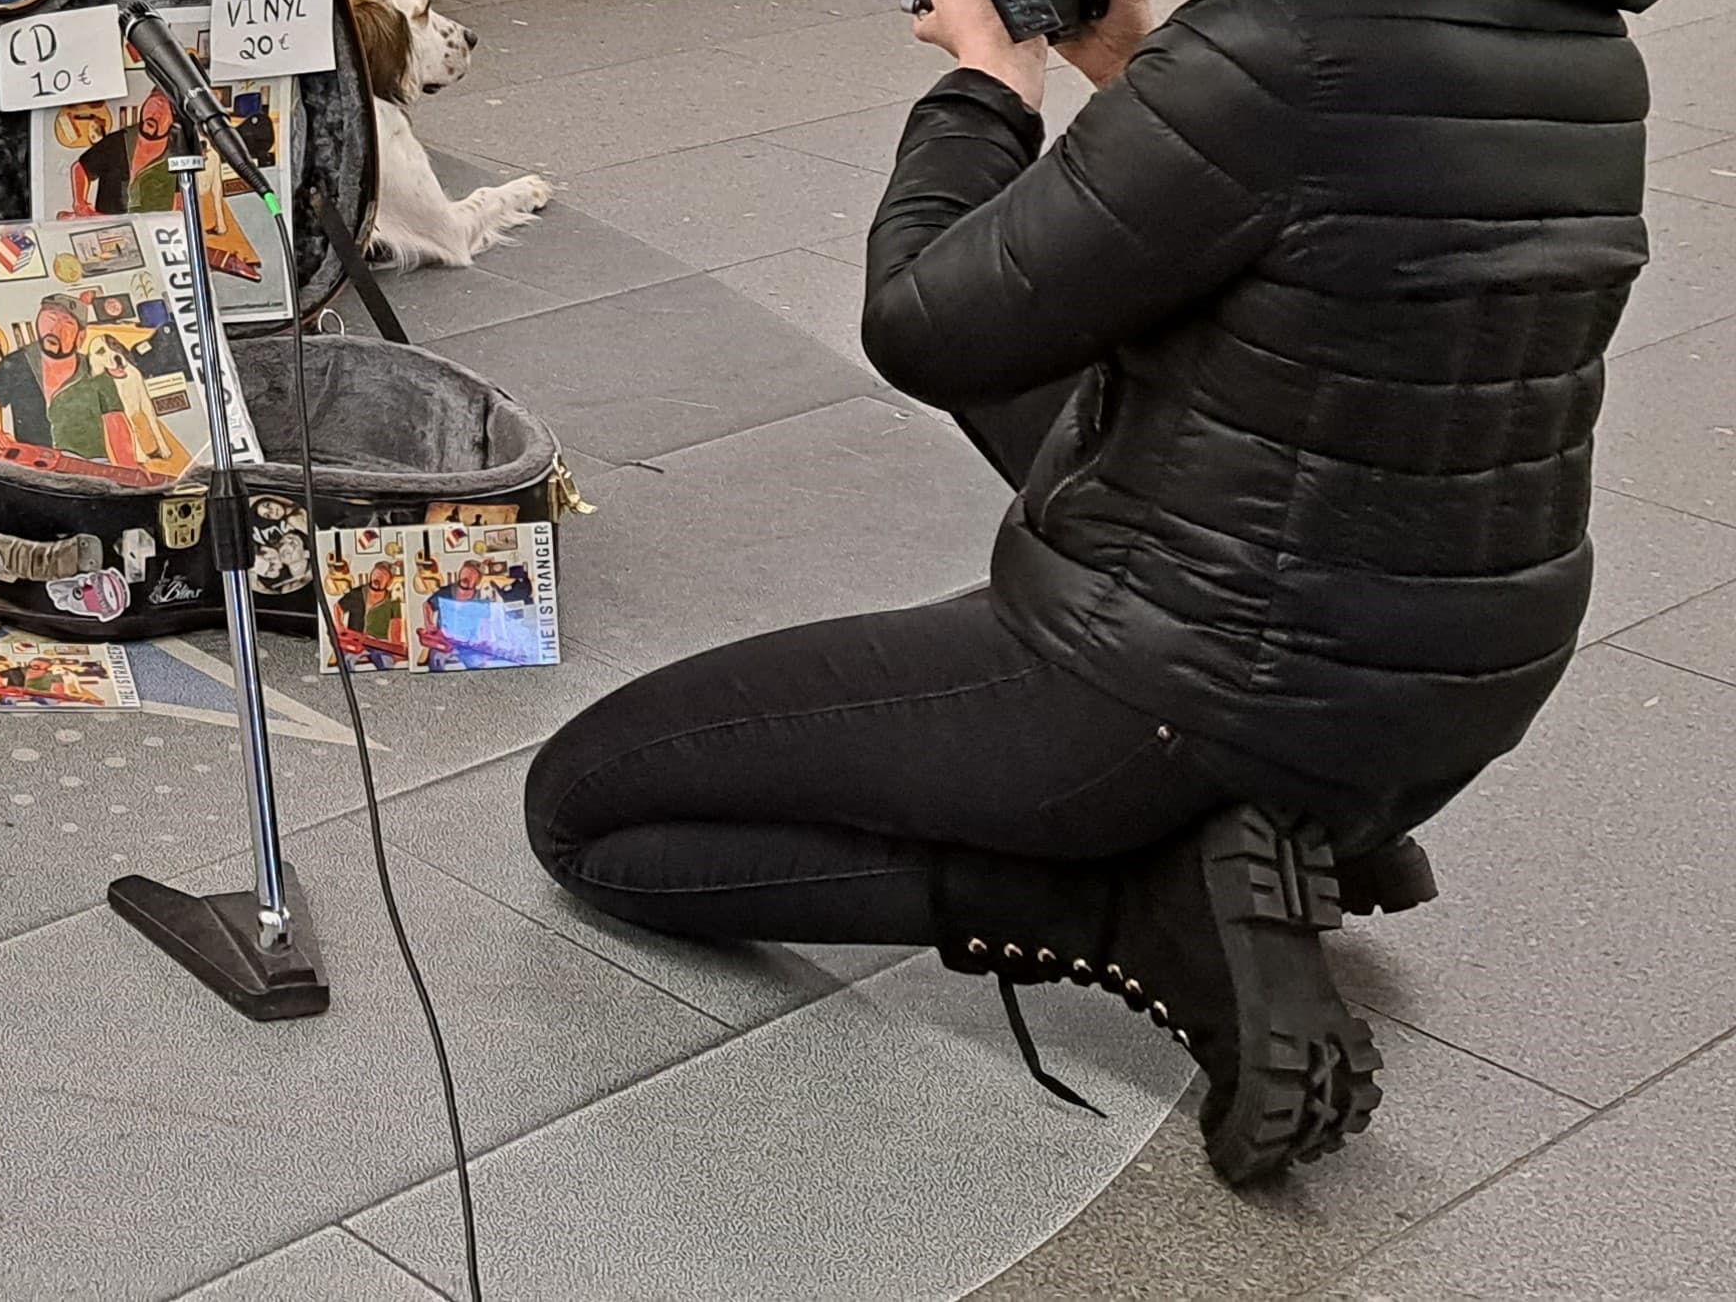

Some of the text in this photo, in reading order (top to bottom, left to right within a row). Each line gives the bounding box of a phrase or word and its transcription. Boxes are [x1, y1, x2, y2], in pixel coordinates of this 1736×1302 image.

[9, 23, 58, 67] CD
[534, 524, 557, 662] THE STRANGER
